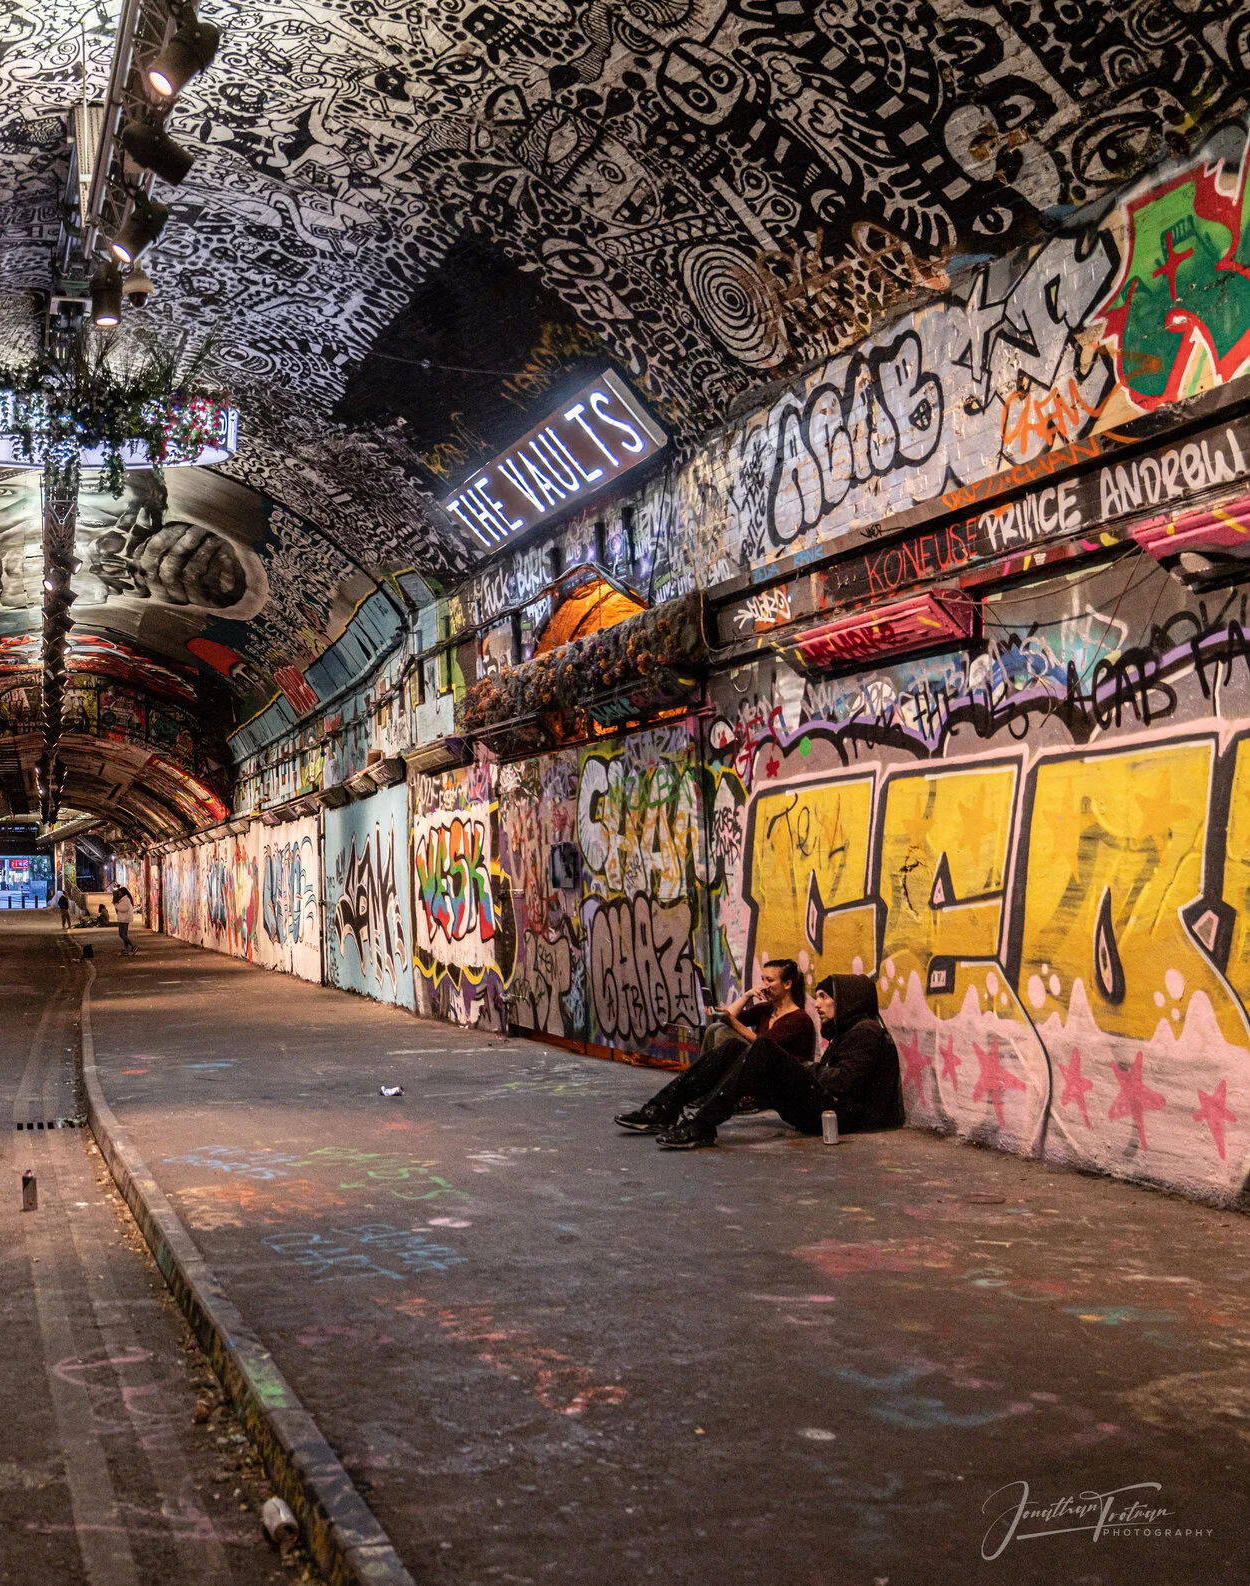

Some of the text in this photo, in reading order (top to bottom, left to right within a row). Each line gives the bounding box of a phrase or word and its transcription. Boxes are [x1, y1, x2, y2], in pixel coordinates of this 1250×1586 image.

[446, 476, 525, 548] THE
[496, 390, 647, 513] VAULTS
[978, 478, 1082, 549] PRINCE
[483, 566, 510, 618] FUCK
[1063, 658, 1178, 731] ACAB
